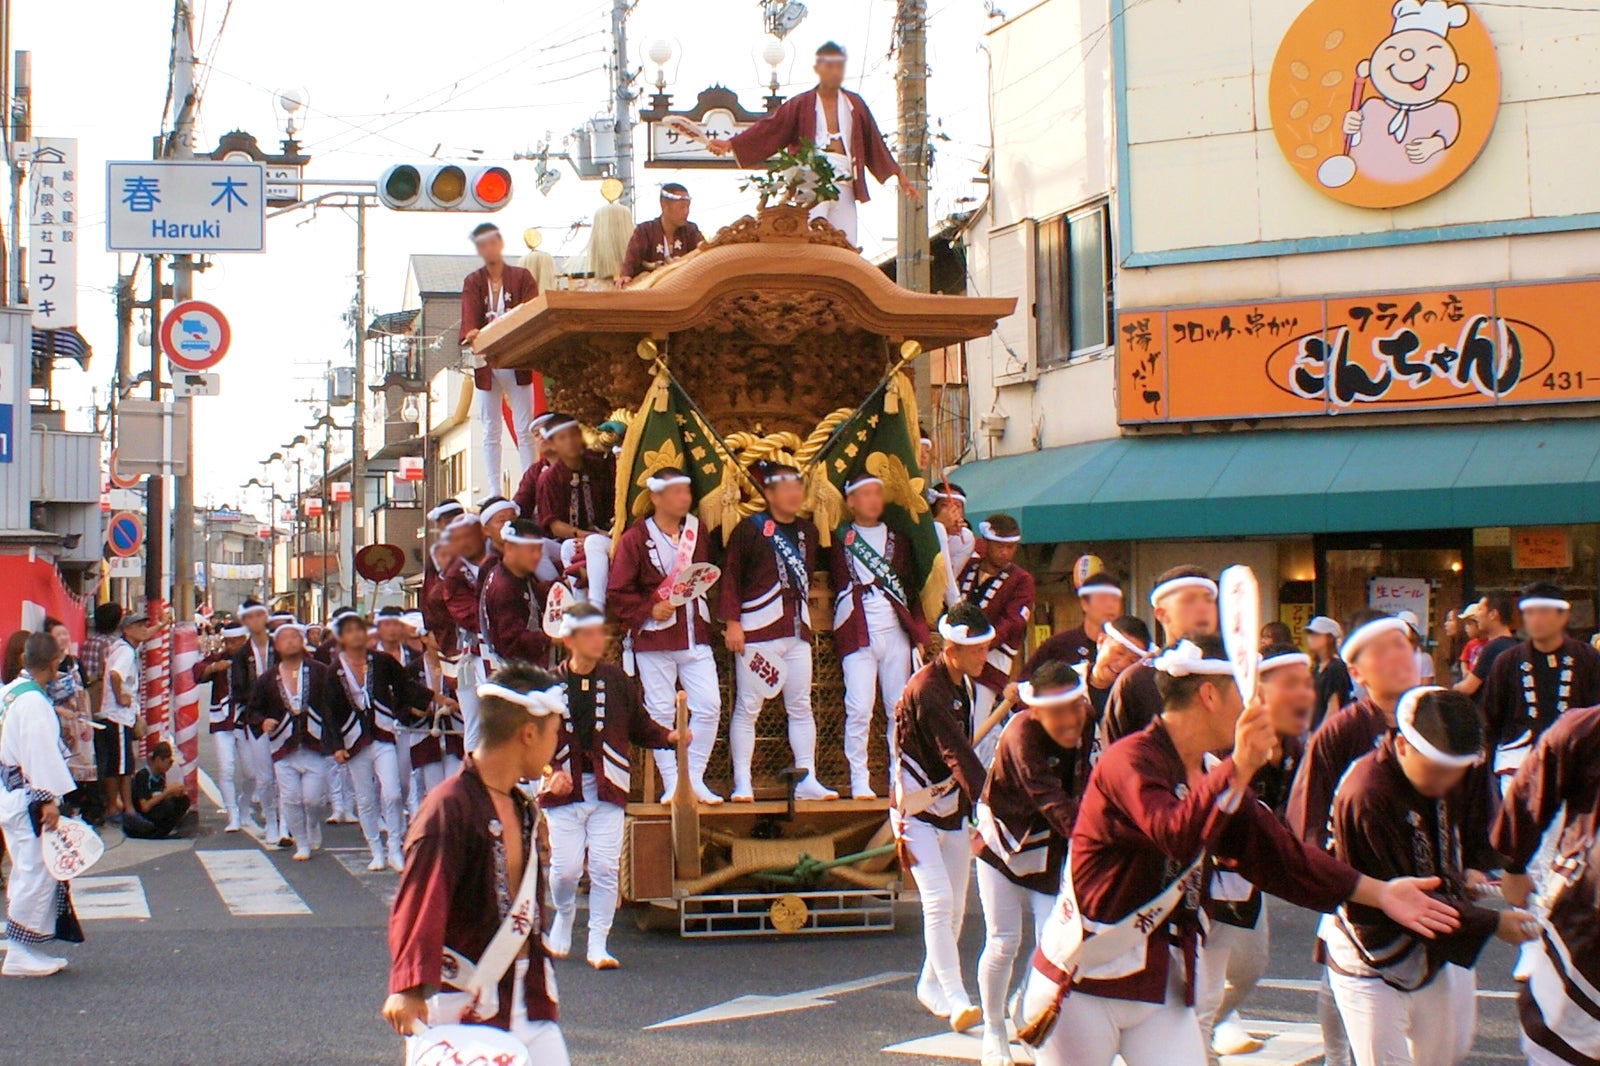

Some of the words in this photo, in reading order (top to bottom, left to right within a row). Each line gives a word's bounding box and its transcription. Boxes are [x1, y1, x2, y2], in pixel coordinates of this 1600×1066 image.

[62, 170, 74, 243] 総合建設
[151, 219, 221, 239] Haruki
[38, 175, 56, 317] 有限会社ユウキ
[1348, 295, 1465, 333] フライの店
[1122, 318, 1161, 415] 揚げたて
[1376, 585, 1425, 599] 生ビール
